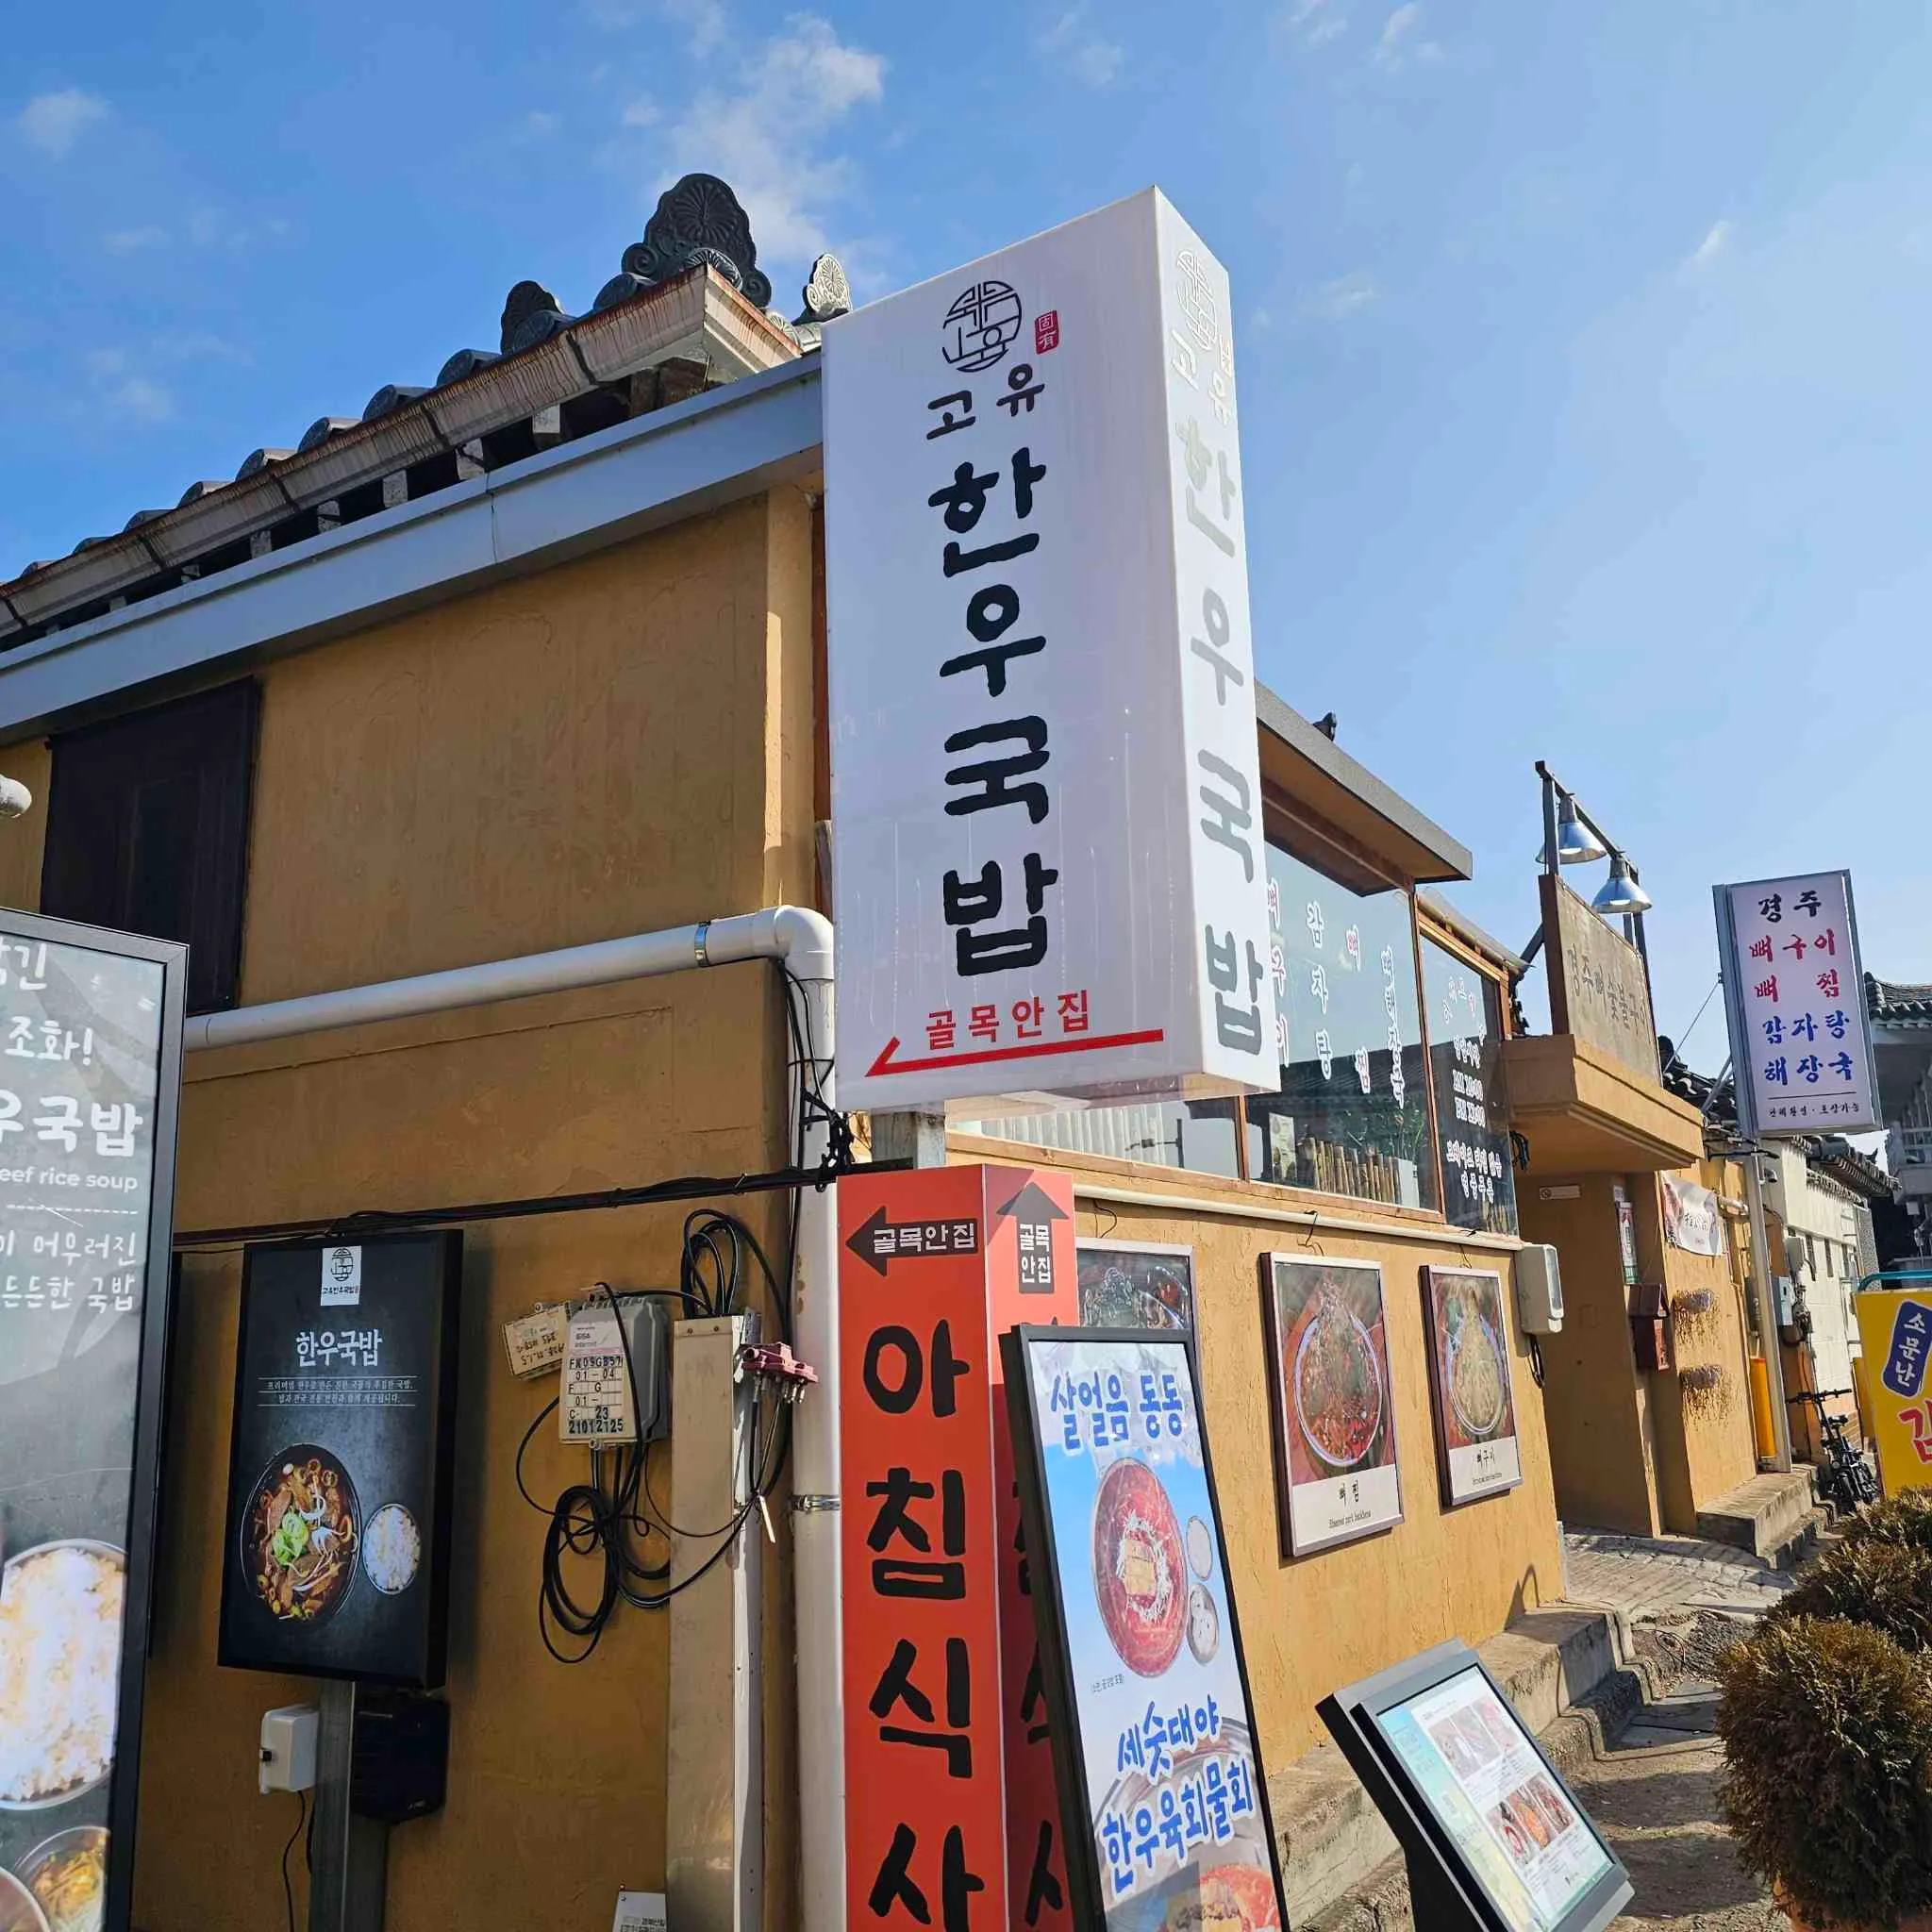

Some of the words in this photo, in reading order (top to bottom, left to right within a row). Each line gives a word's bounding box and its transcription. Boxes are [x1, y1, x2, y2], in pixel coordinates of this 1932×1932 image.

[926, 363, 1045, 440] 고유
[927, 447, 1058, 976] 한우국밥
[1175, 413, 1263, 1056] 한우국밥
[1757, 890, 1822, 924] 경주
[1750, 928, 1836, 962] 뼈구이
[1307, 900, 1333, 1080] 감자탕
[5, 1015, 93, 1065] 조화!
[925, 990, 1090, 1050] 골목안집
[1762, 1009, 1850, 1044] 감자탕
[1764, 1052, 1854, 1085] 해장국
[40, 1167, 81, 1187] rice
[86, 1174, 139, 1193] soup
[34, 1232, 136, 1266] 어우러진
[874, 1222, 975, 1255] 골목안집
[1020, 1224, 1050, 1252] 골목
[1022, 1255, 1051, 1283] 안집
[88, 1274, 136, 1313] 국밥
[295, 1328, 383, 1367] 한우국밥
[1897, 1312, 1926, 1388] 소문난
[1050, 1372, 1130, 1450] 살얼음
[1140, 1374, 1183, 1440] 동동
[863, 1319, 985, 1932] 아침식사
[1117, 1694, 1220, 1778] 세숫대야
[1103, 1758, 1253, 1893] 한우육회물회
